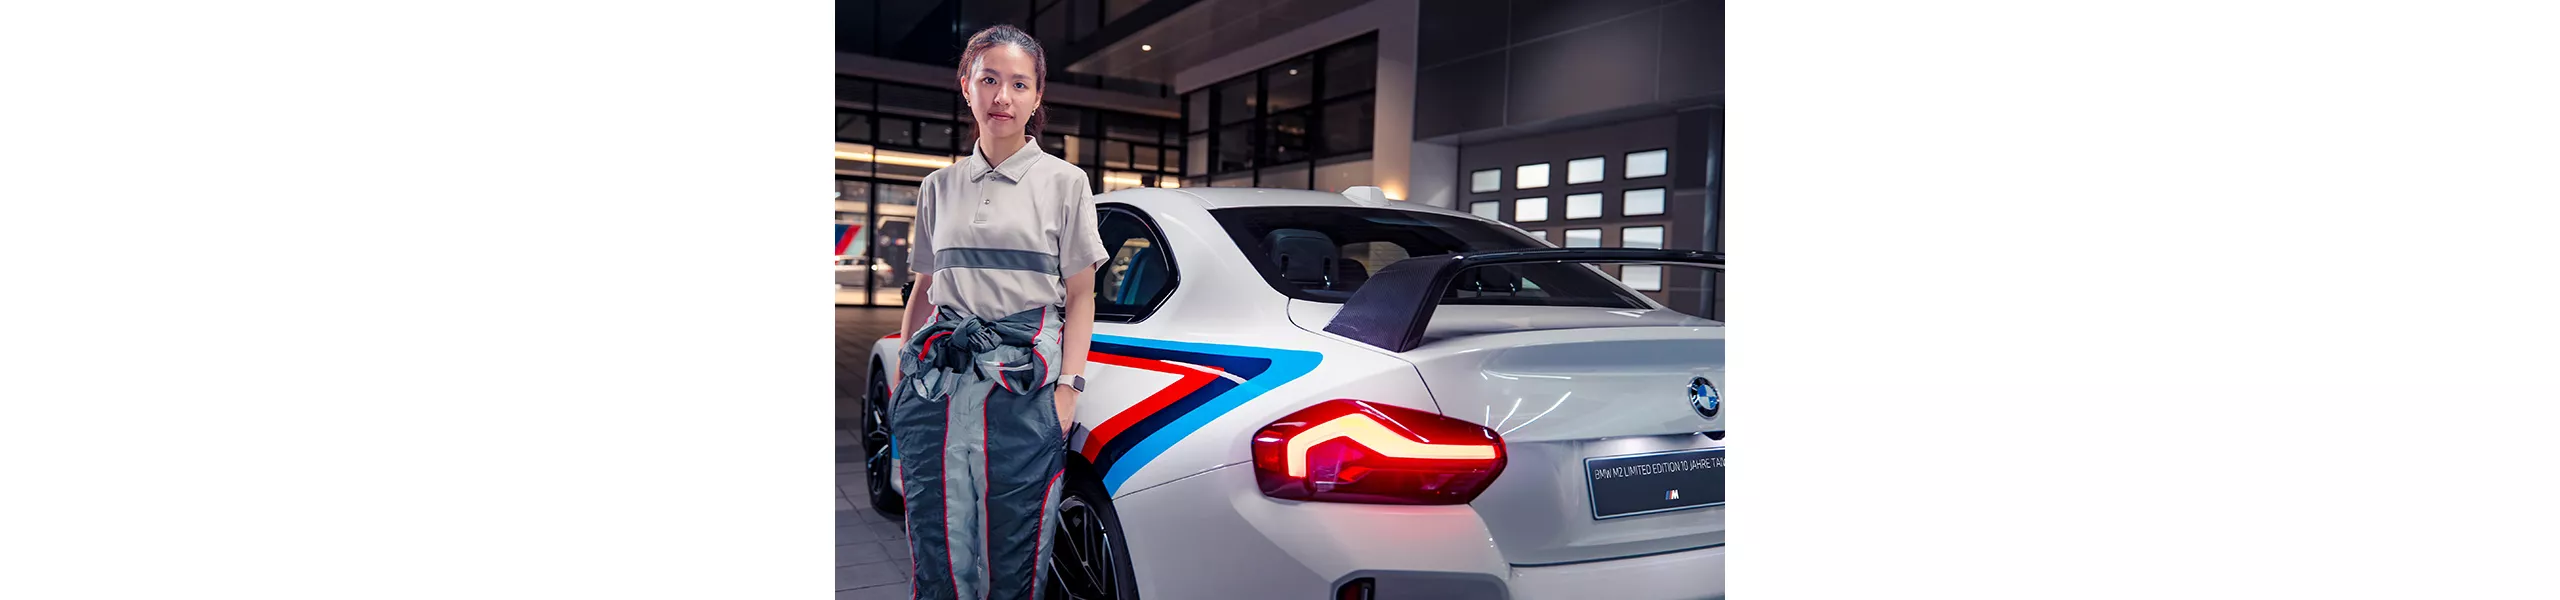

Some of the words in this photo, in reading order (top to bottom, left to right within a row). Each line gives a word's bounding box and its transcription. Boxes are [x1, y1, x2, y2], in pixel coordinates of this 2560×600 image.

[1595, 468, 1612, 480] BMW
[1612, 466, 1624, 478] M2
[1624, 464, 1651, 477] LIMITED
[1652, 462, 1681, 474] EDITION
[1680, 460, 1689, 471] 10
[1689, 458, 1711, 471] JAHRE
